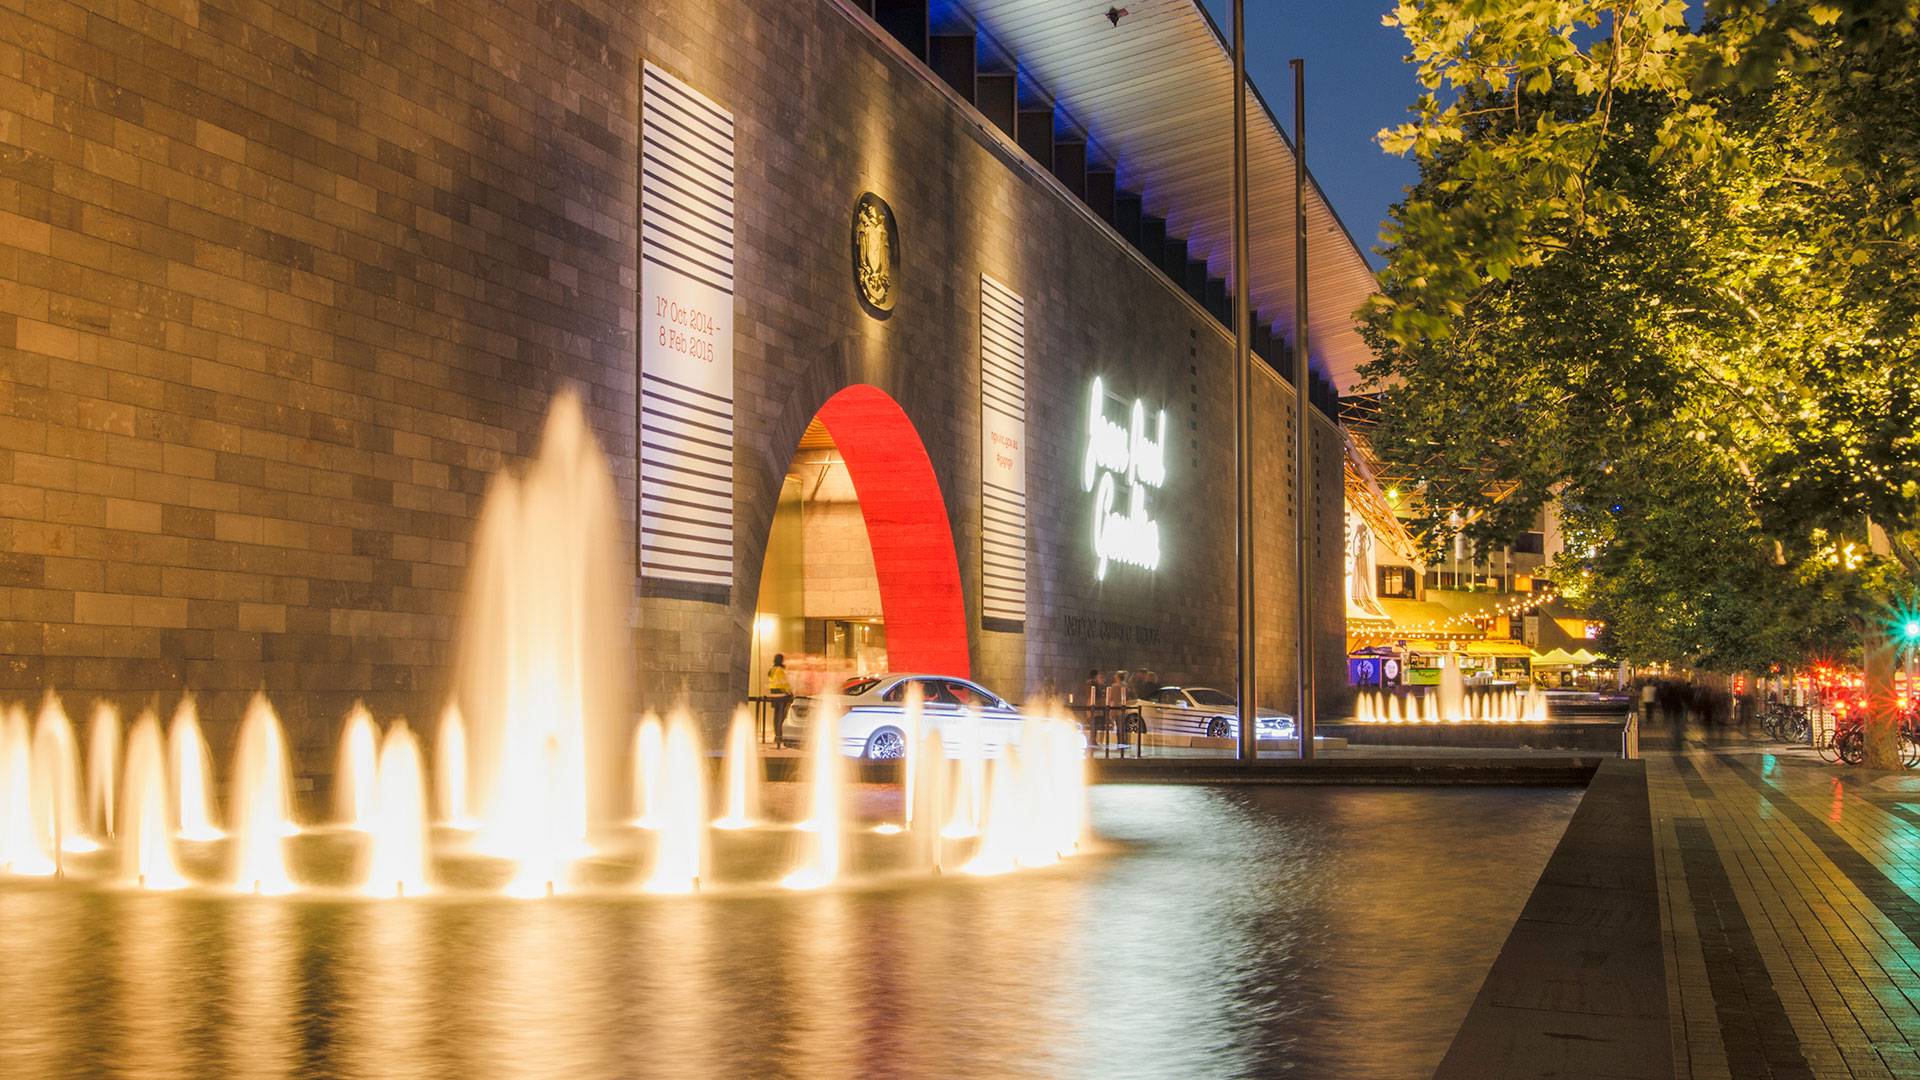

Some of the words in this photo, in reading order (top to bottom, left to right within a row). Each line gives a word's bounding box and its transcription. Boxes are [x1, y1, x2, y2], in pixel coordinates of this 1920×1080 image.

[656, 295, 668, 319] 17
[670, 302, 687, 326] Oct
[659, 325, 666, 346] 8
[669, 329, 687, 354] Feb
[689, 337, 714, 363] 2015
